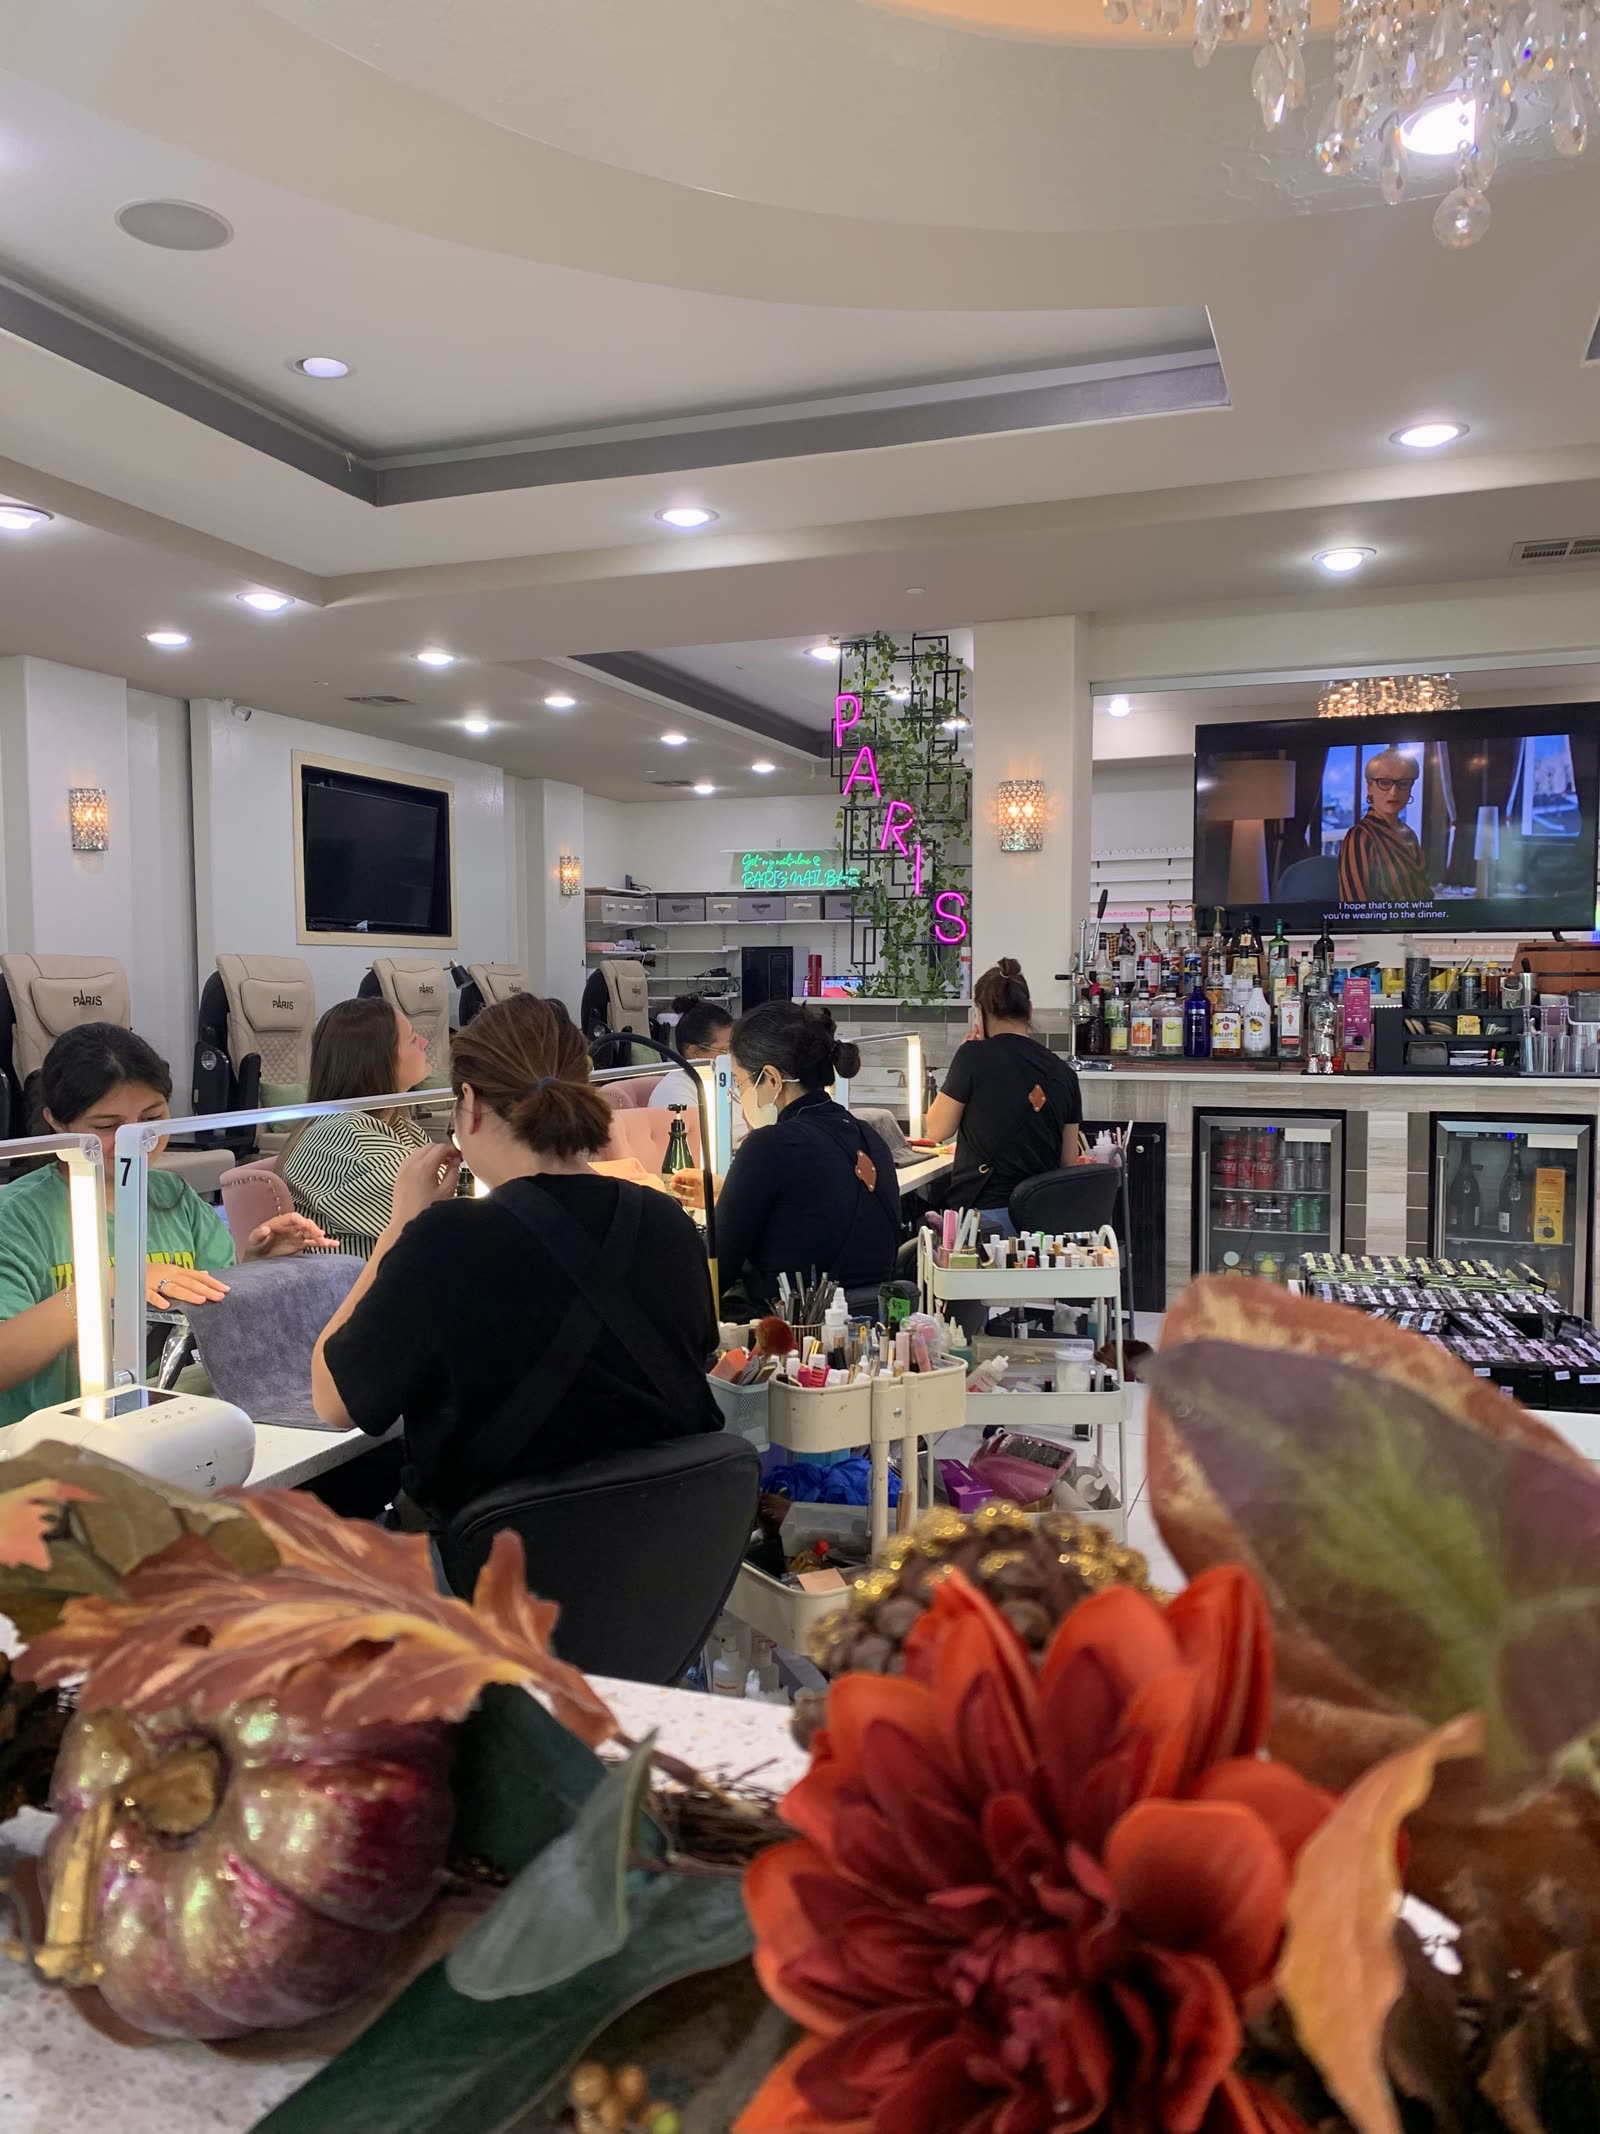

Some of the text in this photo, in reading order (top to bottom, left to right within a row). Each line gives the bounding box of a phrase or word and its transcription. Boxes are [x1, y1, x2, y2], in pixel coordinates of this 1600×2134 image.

[834, 693, 968, 944] PARIS
[742, 866, 861, 890] PARIS NAIL BAR
[1343, 901, 1366, 911] hope
[1368, 901, 1393, 910] that's
[1394, 900, 1409, 910] not
[1411, 899, 1433, 909] what
[1323, 908, 1449, 921] you're wearing to the dinner.
[418, 981, 434, 994] PARIS
[73, 989, 103, 1007] PARIS
[272, 994, 294, 1011] PARIS
[719, 1072, 727, 1088] 9
[120, 1157, 132, 1187] 7
